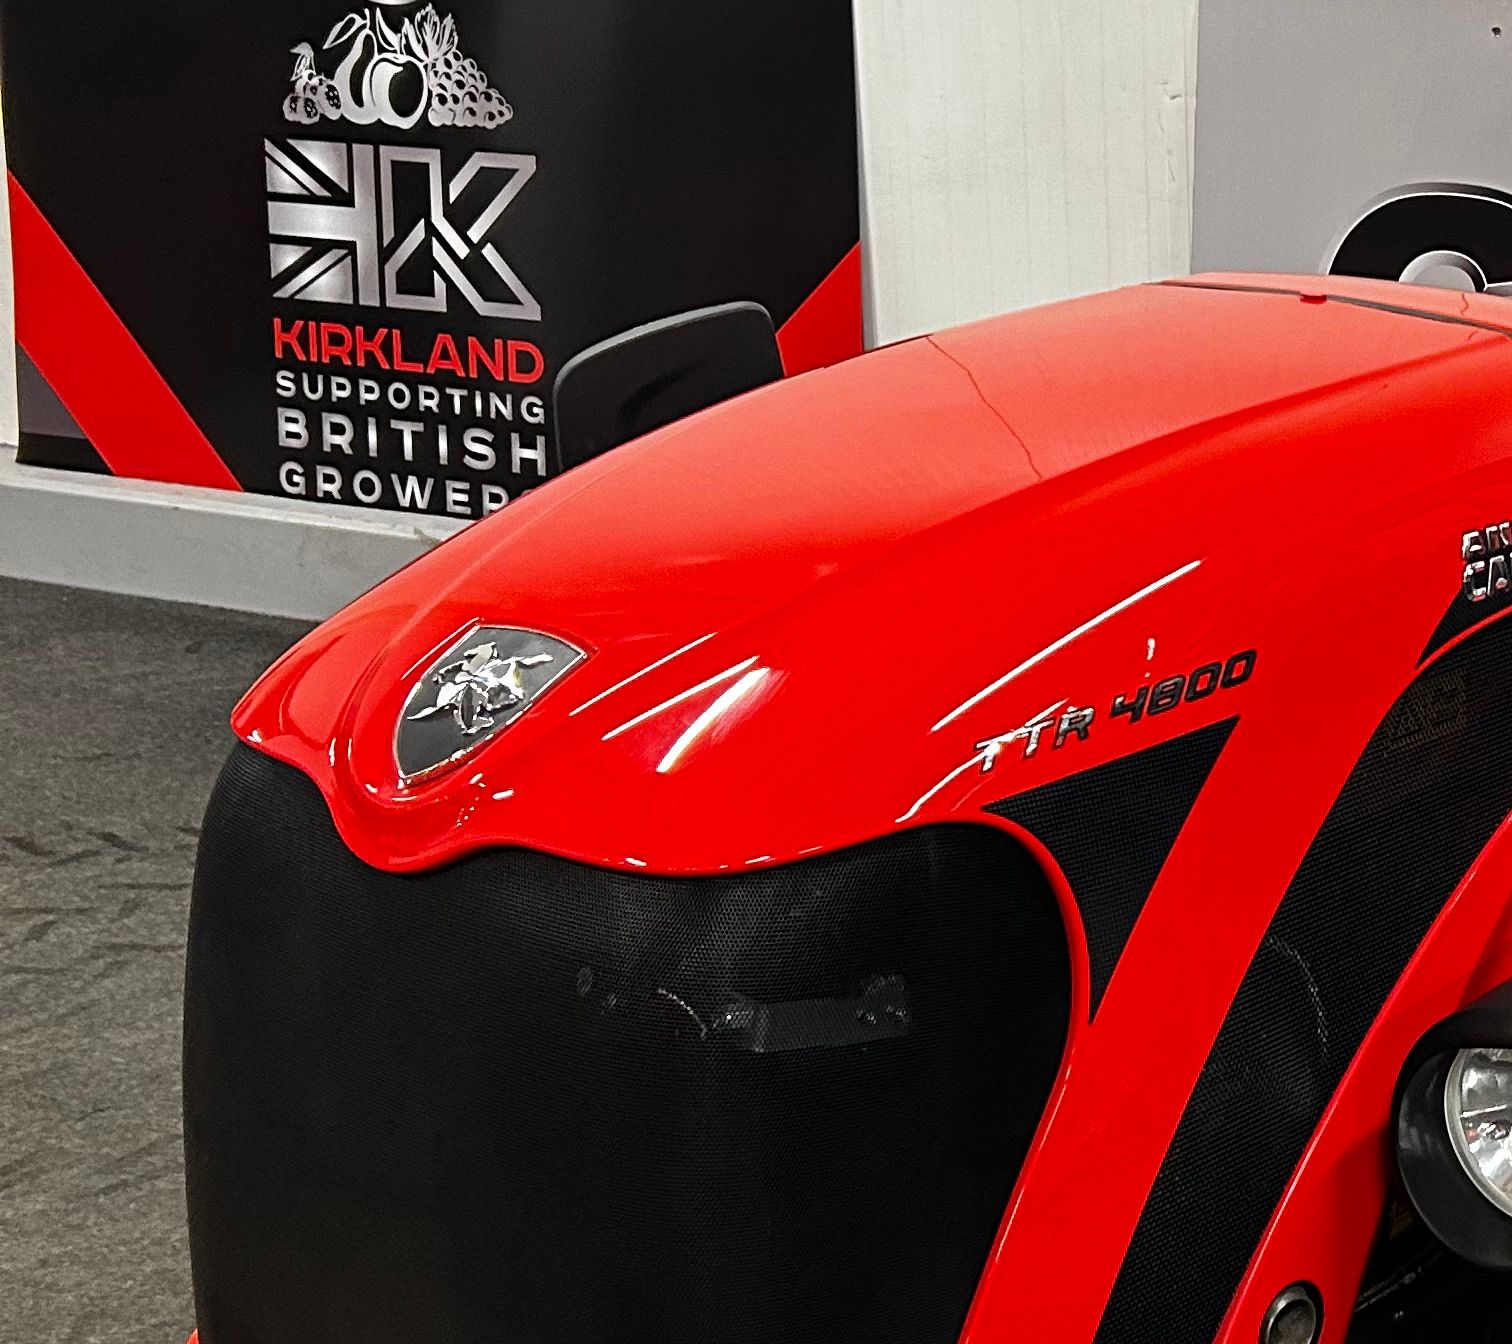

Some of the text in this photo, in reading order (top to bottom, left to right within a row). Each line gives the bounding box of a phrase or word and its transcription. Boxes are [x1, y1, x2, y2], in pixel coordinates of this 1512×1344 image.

[272, 317, 546, 384] KIRKLAND
[275, 369, 547, 425] SUPPORTING
[276, 406, 548, 478] BRITISH
[279, 459, 533, 518] GROWER
[973, 648, 1259, 776] TTR 4800
